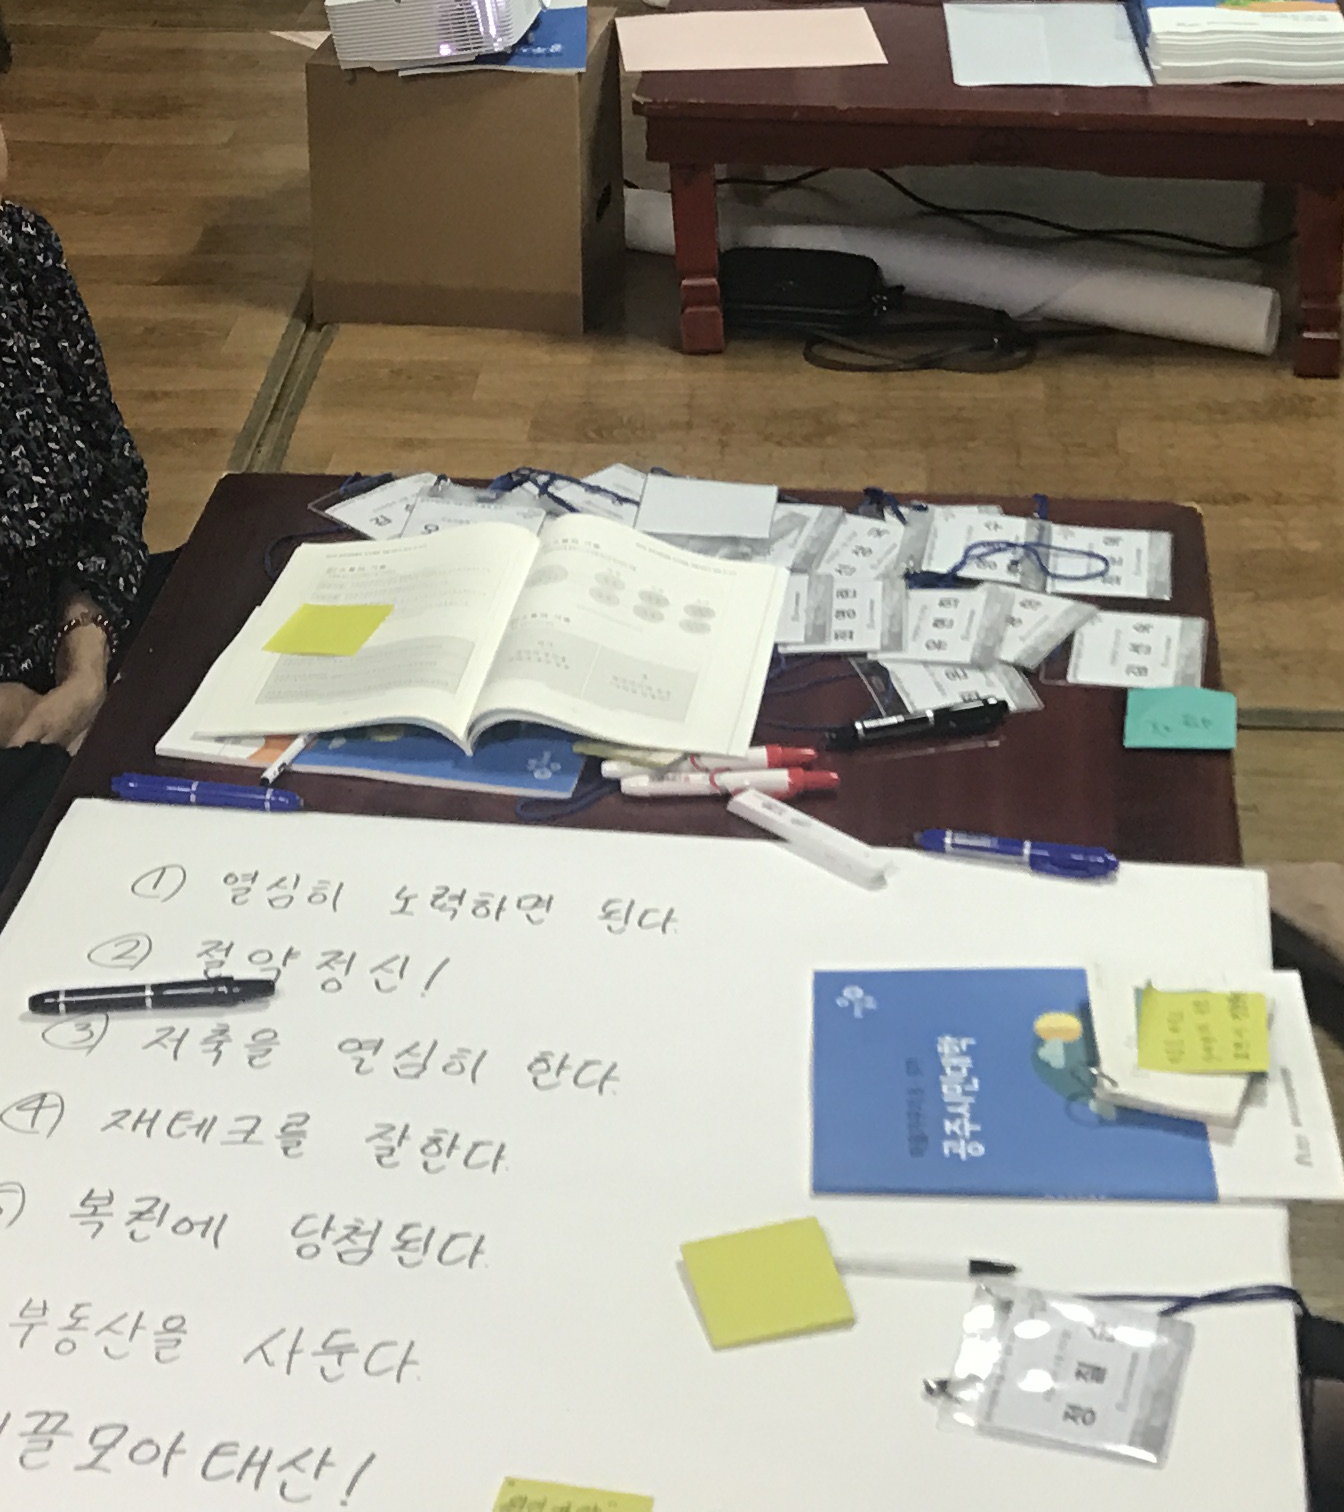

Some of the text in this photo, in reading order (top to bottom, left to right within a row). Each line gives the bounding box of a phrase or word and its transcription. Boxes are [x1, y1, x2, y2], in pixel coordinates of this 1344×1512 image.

[223, 870, 344, 912] 열심히
[391, 886, 553, 925] 노력하면
[142, 1024, 279, 1069] 저축을
[338, 1038, 487, 1084] 열심히
[936, 1034, 986, 1162] 공주시민대학
[101, 1108, 310, 1158] 재테크를
[70, 1188, 228, 1249] 복권에
[10, 1298, 187, 1364] 부동산을
